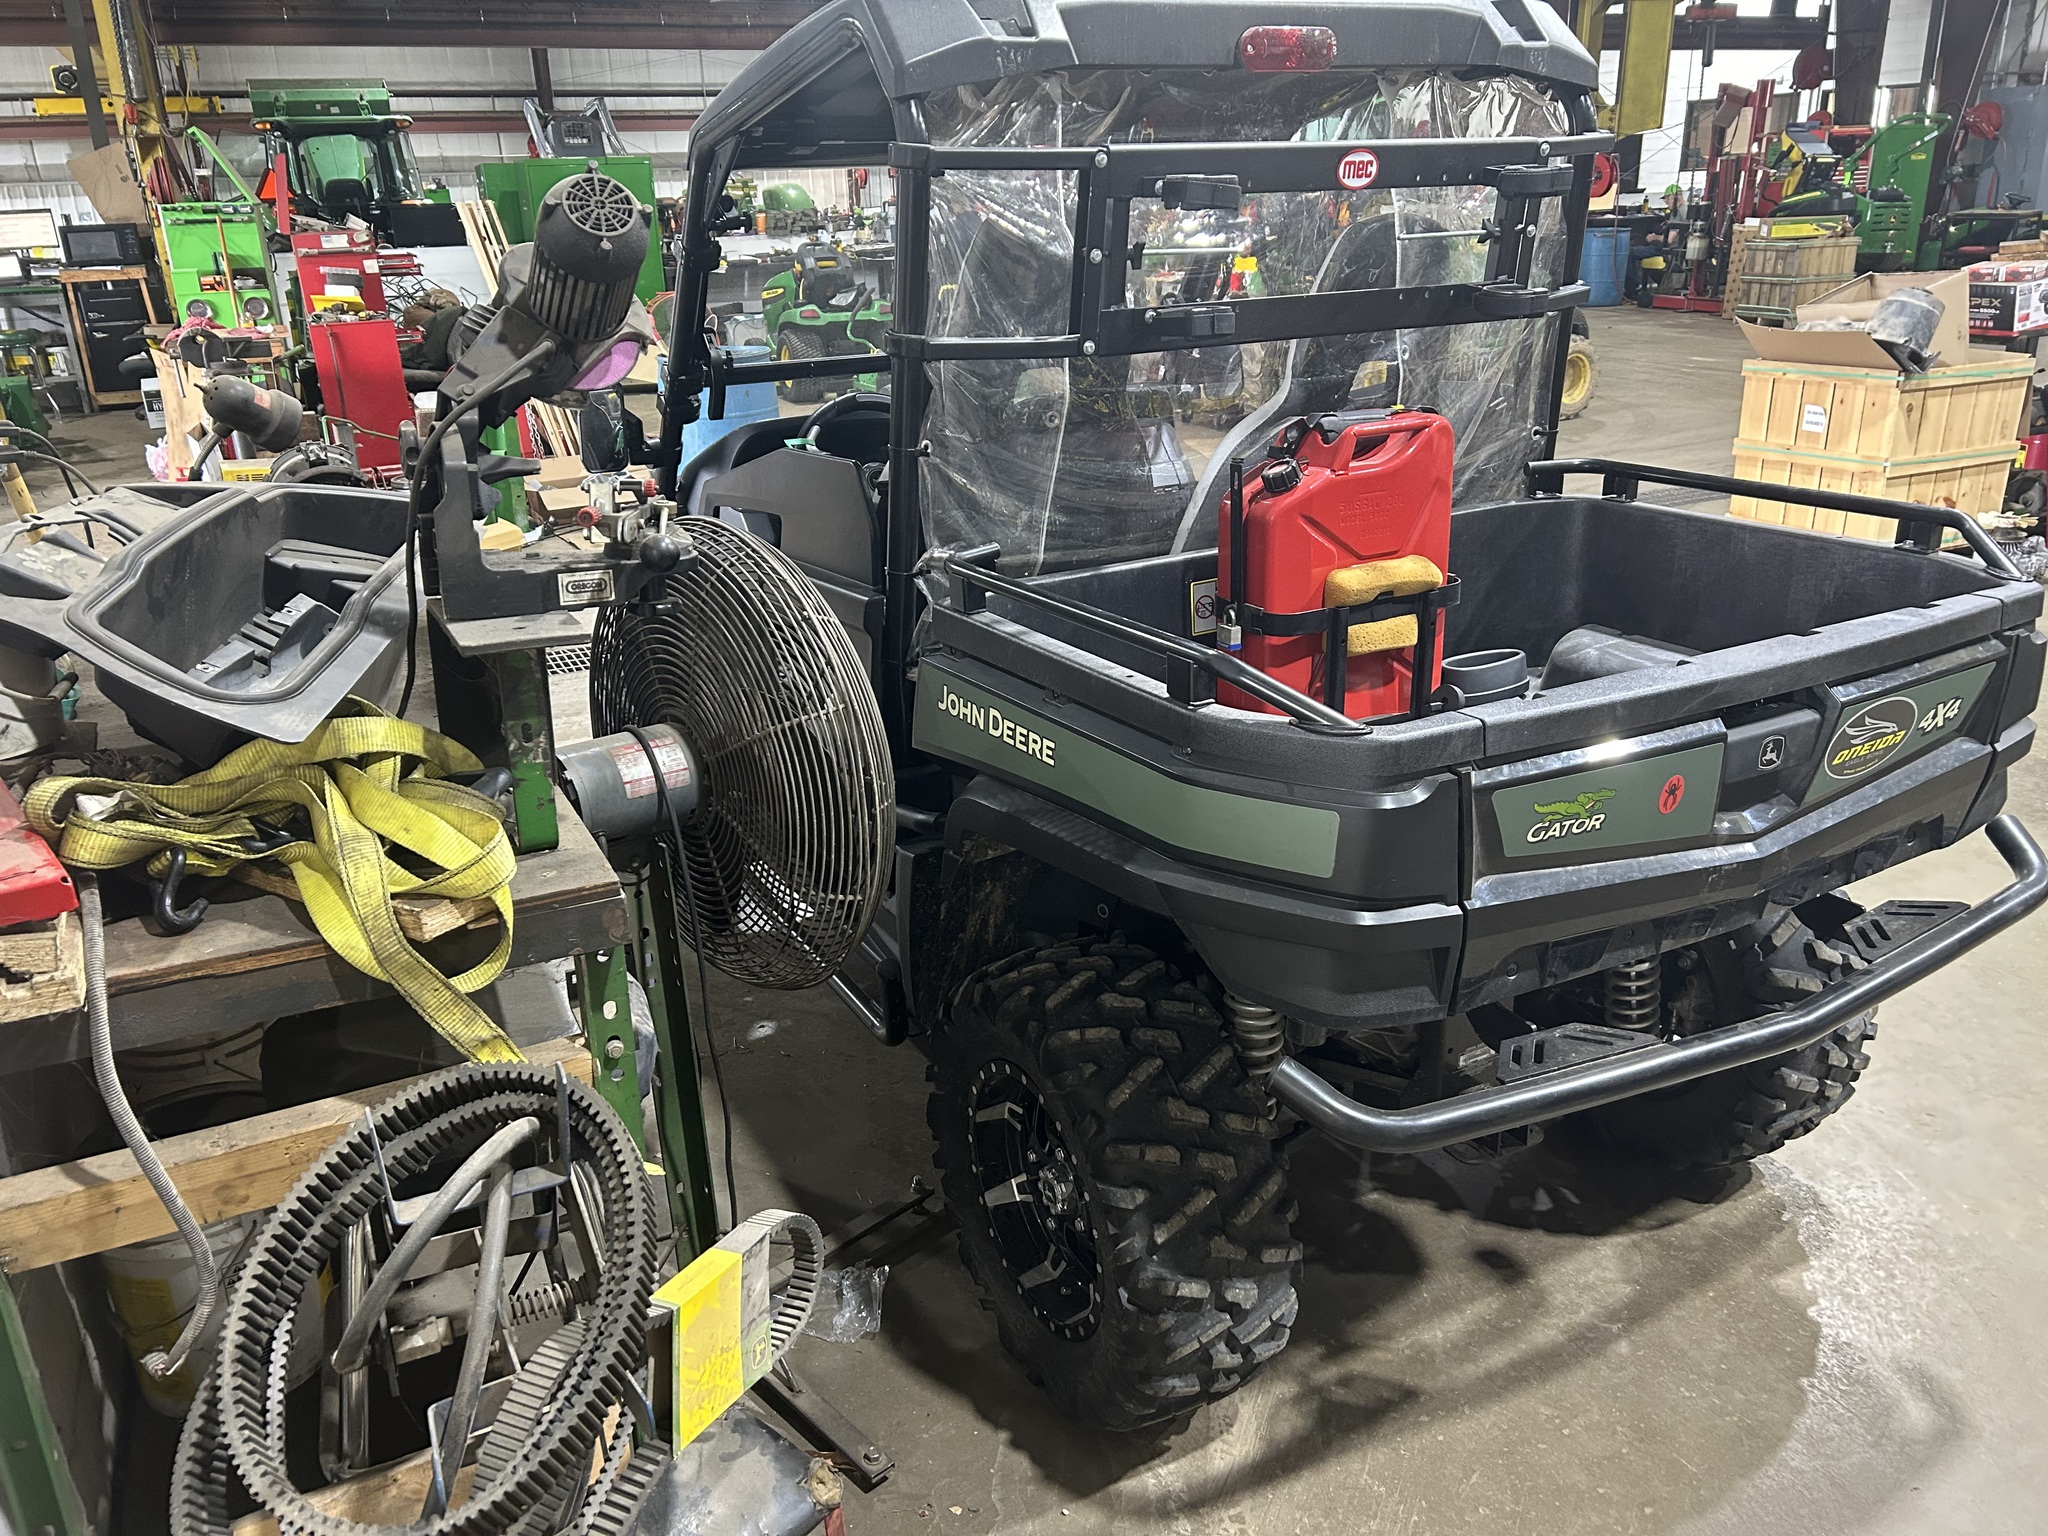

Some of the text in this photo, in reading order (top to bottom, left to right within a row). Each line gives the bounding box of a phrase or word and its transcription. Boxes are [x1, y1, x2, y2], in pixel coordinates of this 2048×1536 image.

[1342, 160, 1374, 179] mec
[1967, 297, 2002, 307] PEX
[570, 580, 603, 591] OREGON
[938, 684, 1056, 767] JOHN DEERE
[1918, 697, 1963, 734] 4X4
[1831, 730, 1907, 765] ONEIDA
[1526, 813, 1606, 843] GATOR
